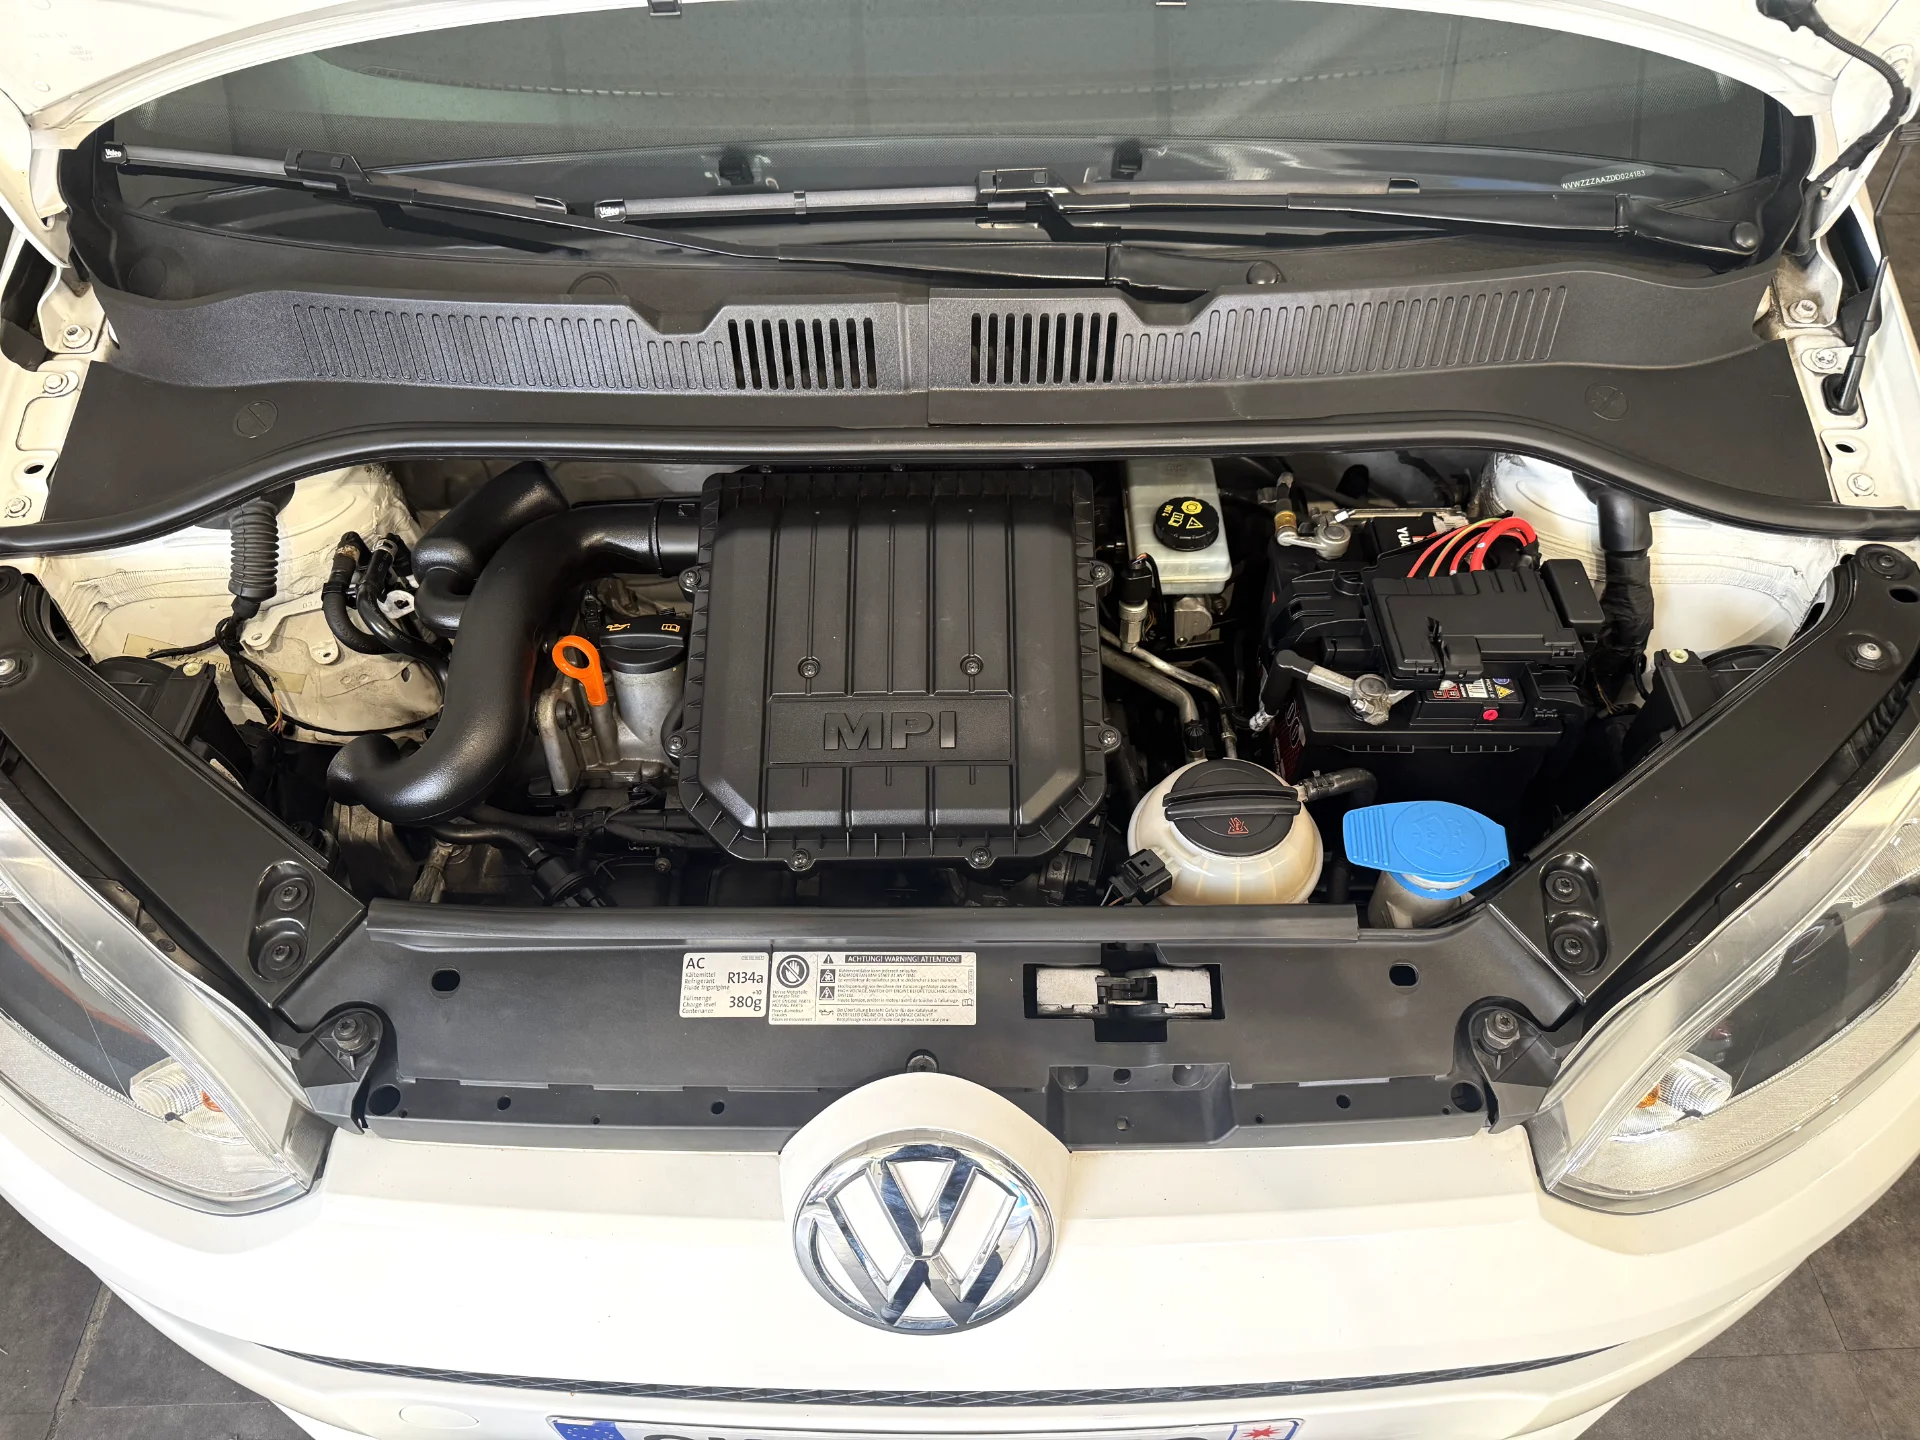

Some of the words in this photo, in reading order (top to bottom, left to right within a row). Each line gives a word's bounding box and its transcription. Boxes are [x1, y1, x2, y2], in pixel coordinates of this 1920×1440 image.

[823, 710, 957, 751] MPI
[685, 957, 706, 970] AC
[847, 955, 883, 963] ACHTUNG!
[884, 955, 919, 963] WARNING!
[920, 955, 960, 963] ATTENTION!
[727, 971, 764, 984] R134a
[729, 995, 762, 1012] 380g
